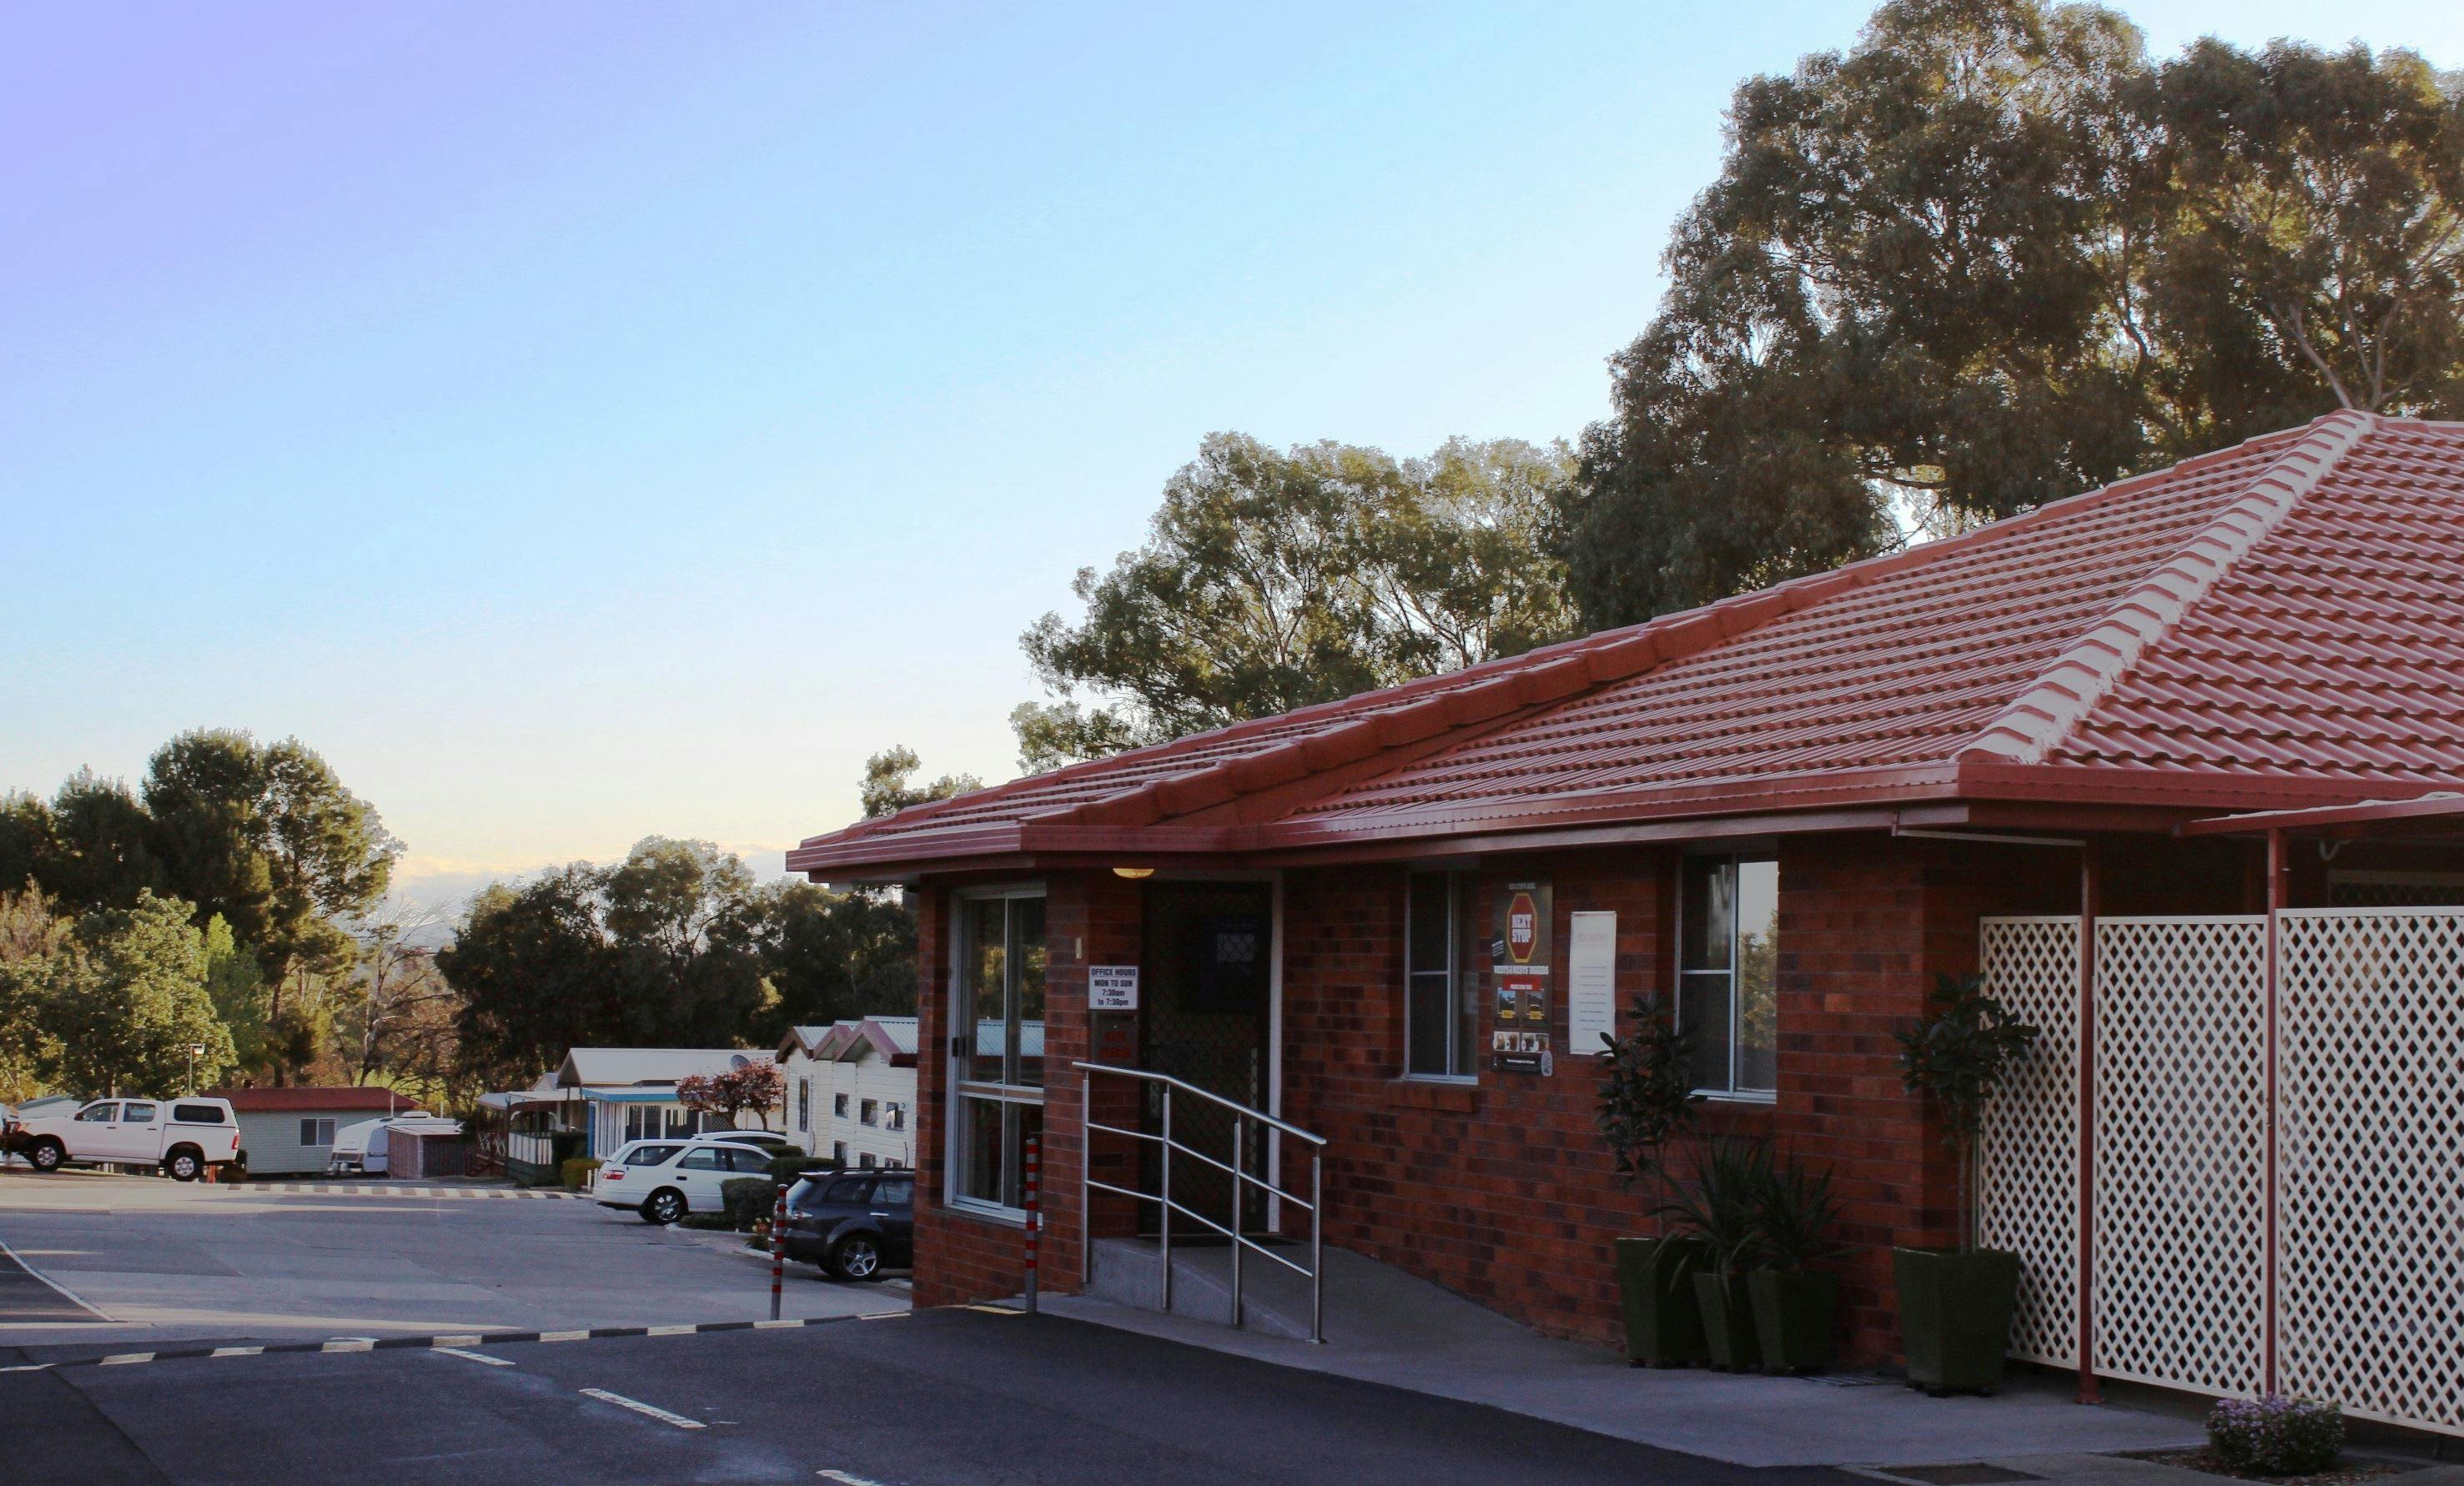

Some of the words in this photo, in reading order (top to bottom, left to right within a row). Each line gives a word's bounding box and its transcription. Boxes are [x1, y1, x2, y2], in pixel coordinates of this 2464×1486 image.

[1512, 929, 1531, 943] STOP
[1094, 979, 1109, 987] MON
[1110, 979, 1119, 987] TO
[1120, 979, 1133, 987] SUN
